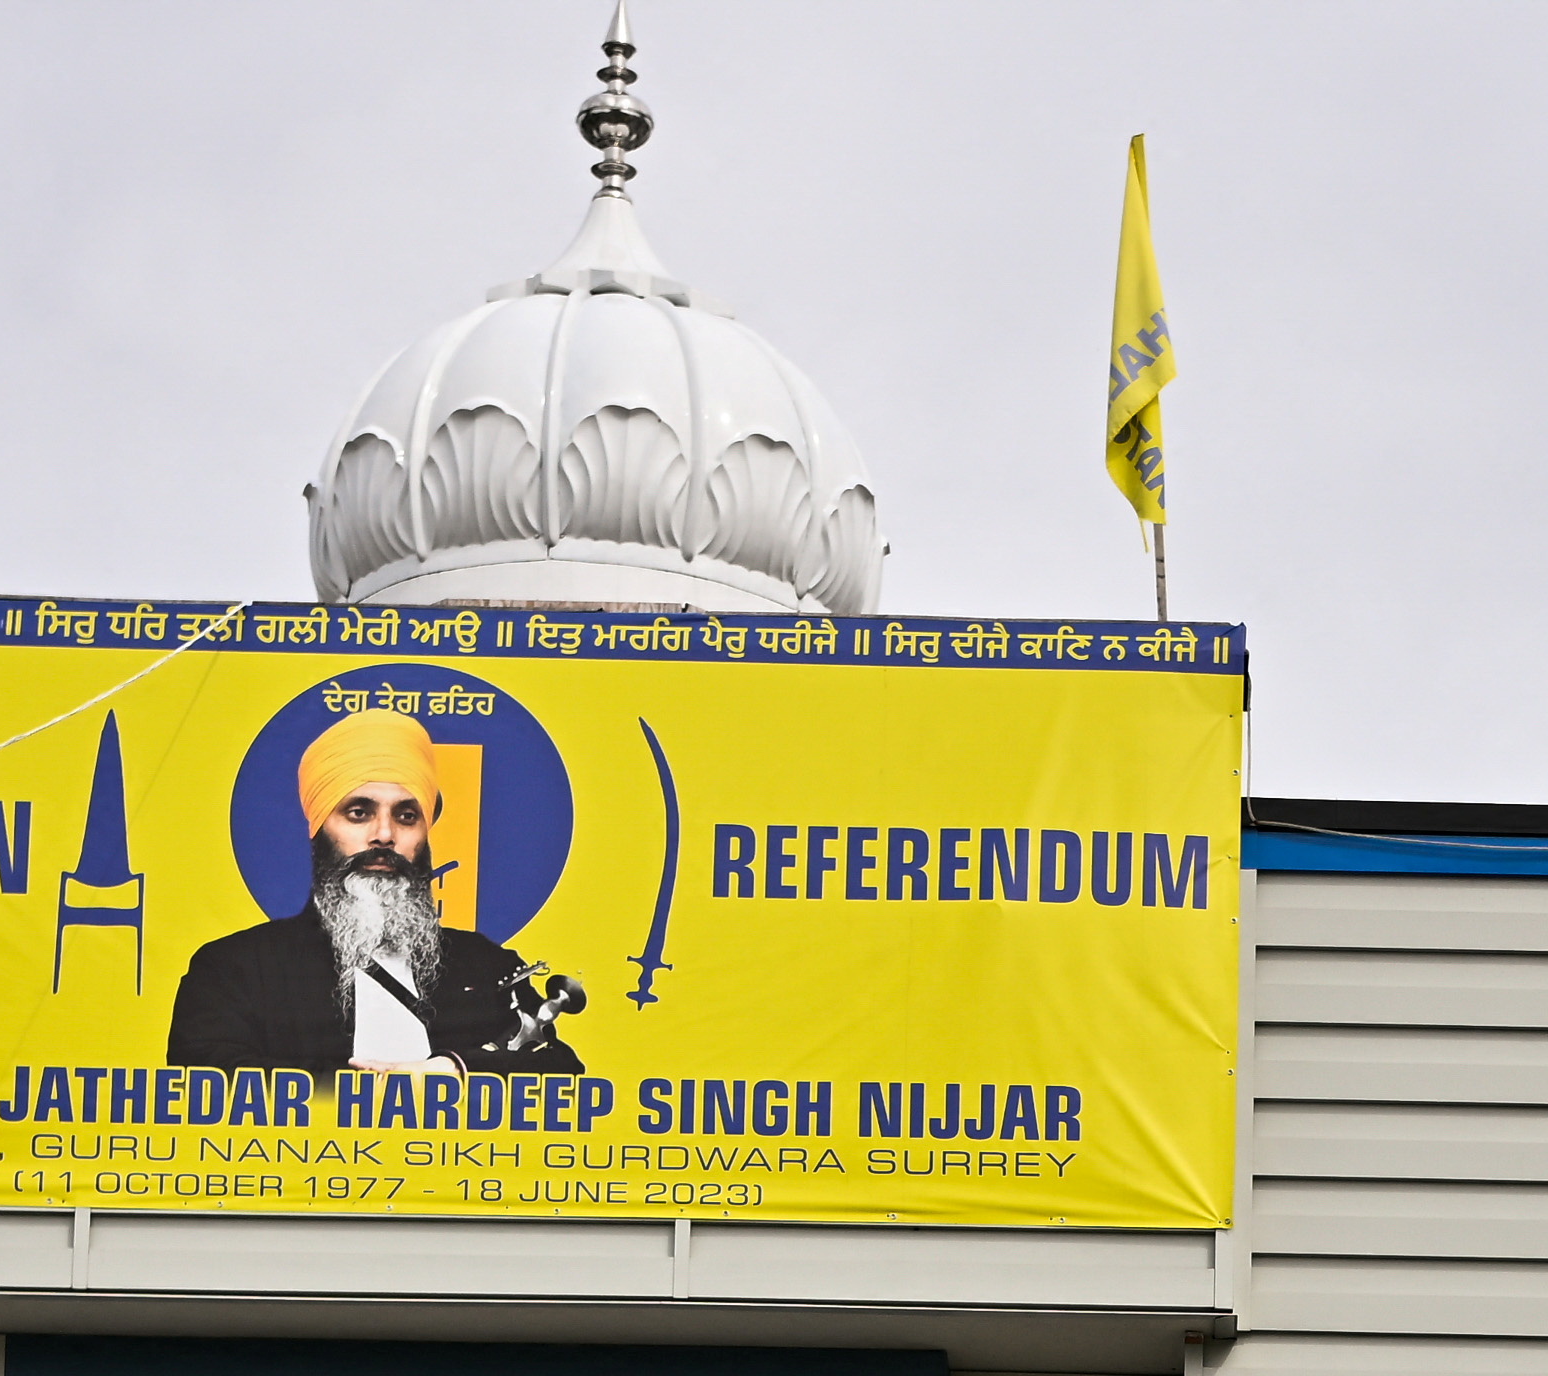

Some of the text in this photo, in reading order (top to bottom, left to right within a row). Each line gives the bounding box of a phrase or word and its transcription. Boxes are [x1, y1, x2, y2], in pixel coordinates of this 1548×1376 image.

[34, 600, 99, 645] ਸਿਰੁ
[105, 603, 169, 641] ਧਰਿ
[175, 604, 247, 644] ਤਲੀ
[253, 607, 331, 645] ਗਲੀ
[337, 606, 401, 648] ਮੇਰੀ
[408, 610, 482, 654] ਆਉ
[525, 614, 585, 656] ਇਤੁ
[591, 616, 693, 652] ਮਾਰਗਿ
[698, 615, 749, 659] ਪੈਰੁ
[754, 618, 839, 655] ਧਰੀਜੈ
[882, 621, 943, 664] ਸਿਰੁ
[948, 622, 1011, 660] ਦੀਜੈ
[1017, 625, 1094, 661] ਕਾਣਿ
[1100, 635, 1129, 661] ਨ
[1135, 626, 1199, 663] ਕੀਜੈ
[321, 681, 370, 713] ਦੇਗ
[374, 682, 422, 714] ਤੇਗ
[711, 822, 1210, 911] REFERENDUM
[336, 1071, 616, 1135] HARDEEP
[636, 1077, 833, 1139] SINGH
[858, 1081, 1081, 1143] NIJJAR
[29, 1133, 178, 1163] GURU
[198, 1136, 384, 1168] NANAK
[403, 1140, 522, 1170] SIKH
[542, 1144, 846, 1176] GURDWARA
[866, 1148, 1079, 1180] SURREY
[12, 1170, 76, 1197] (11
[94, 1171, 284, 1199] OCTOBER
[305, 1174, 407, 1201] 1977
[455, 1179, 505, 1203] 18
[518, 1179, 630, 1205] JUNE
[643, 1181, 764, 1208] 2023)
